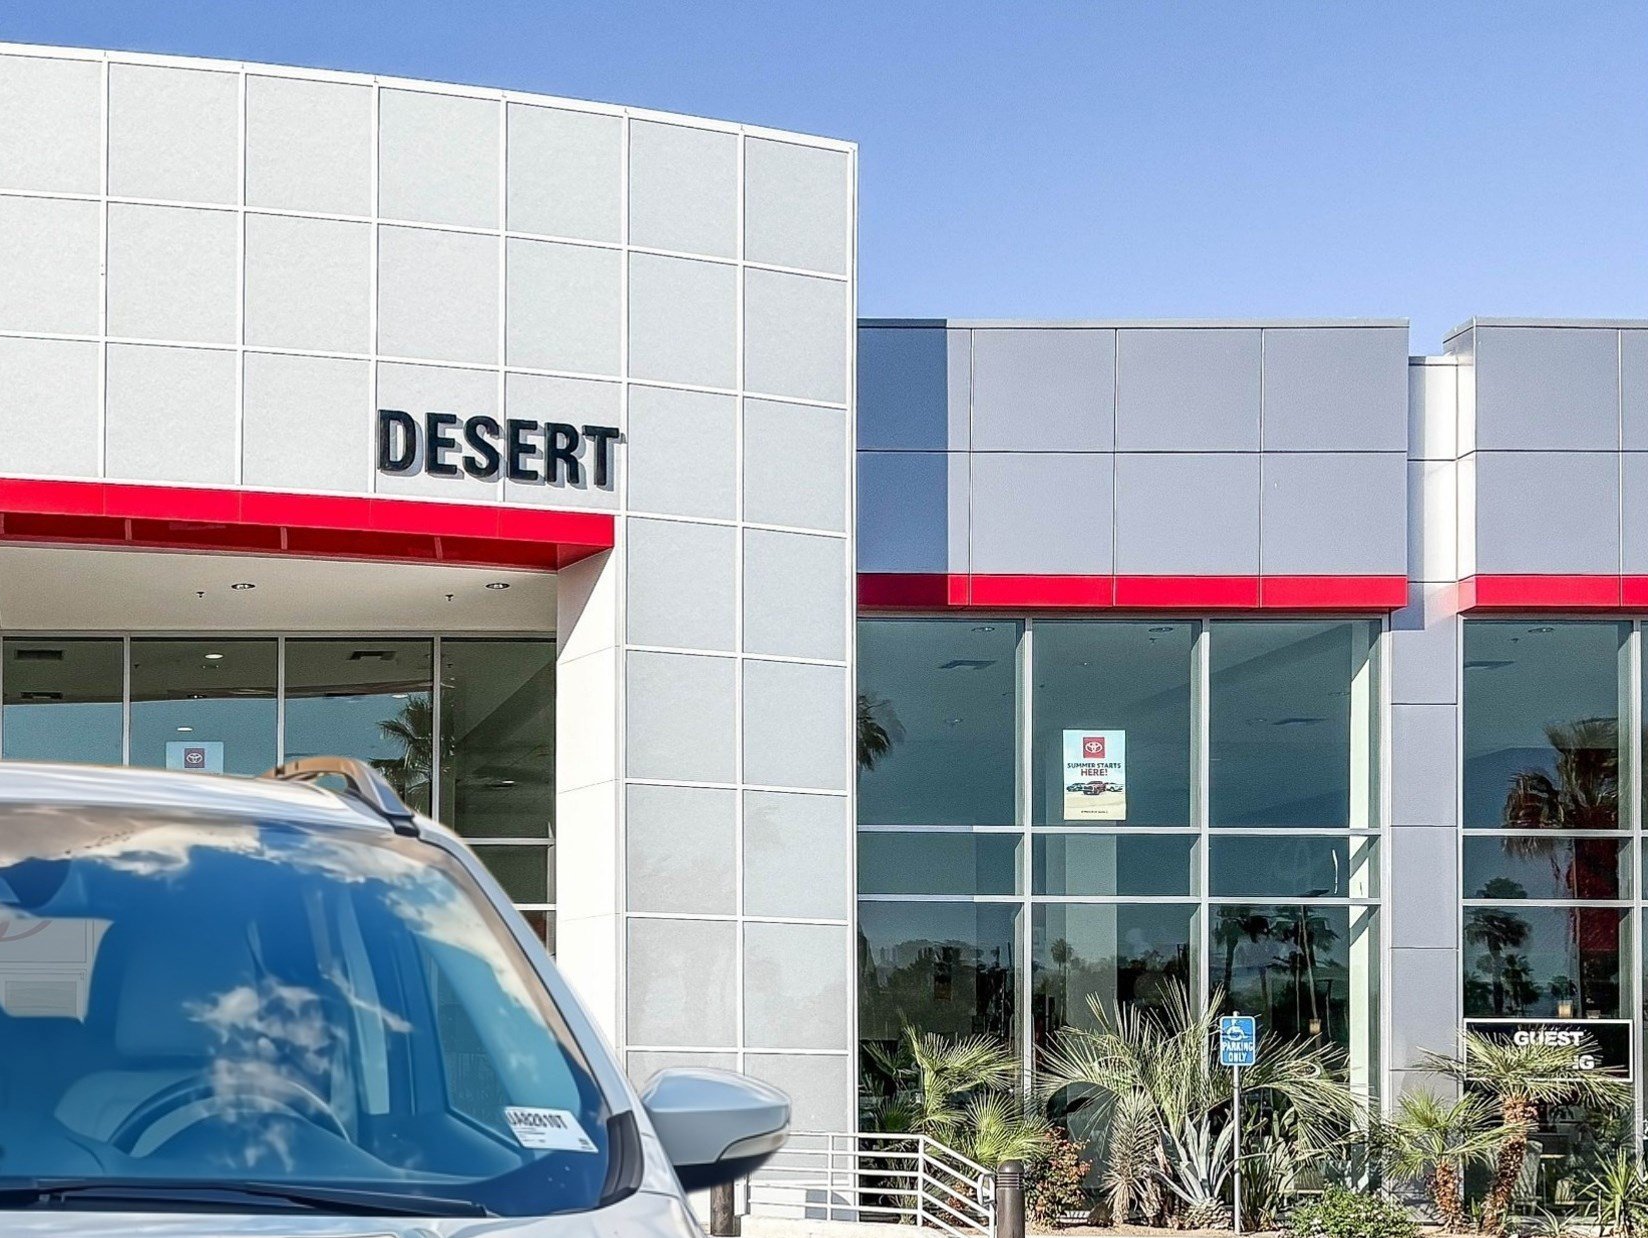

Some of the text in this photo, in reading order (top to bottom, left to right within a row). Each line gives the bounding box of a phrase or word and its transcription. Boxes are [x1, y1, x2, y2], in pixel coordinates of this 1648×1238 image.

[377, 409, 620, 486] DESERT
[1080, 768, 1108, 776] HERE!
[1513, 1030, 1584, 1047] GUEST
[1222, 1040, 1253, 1052] PARKING
[1228, 1051, 1247, 1062] ONLY
